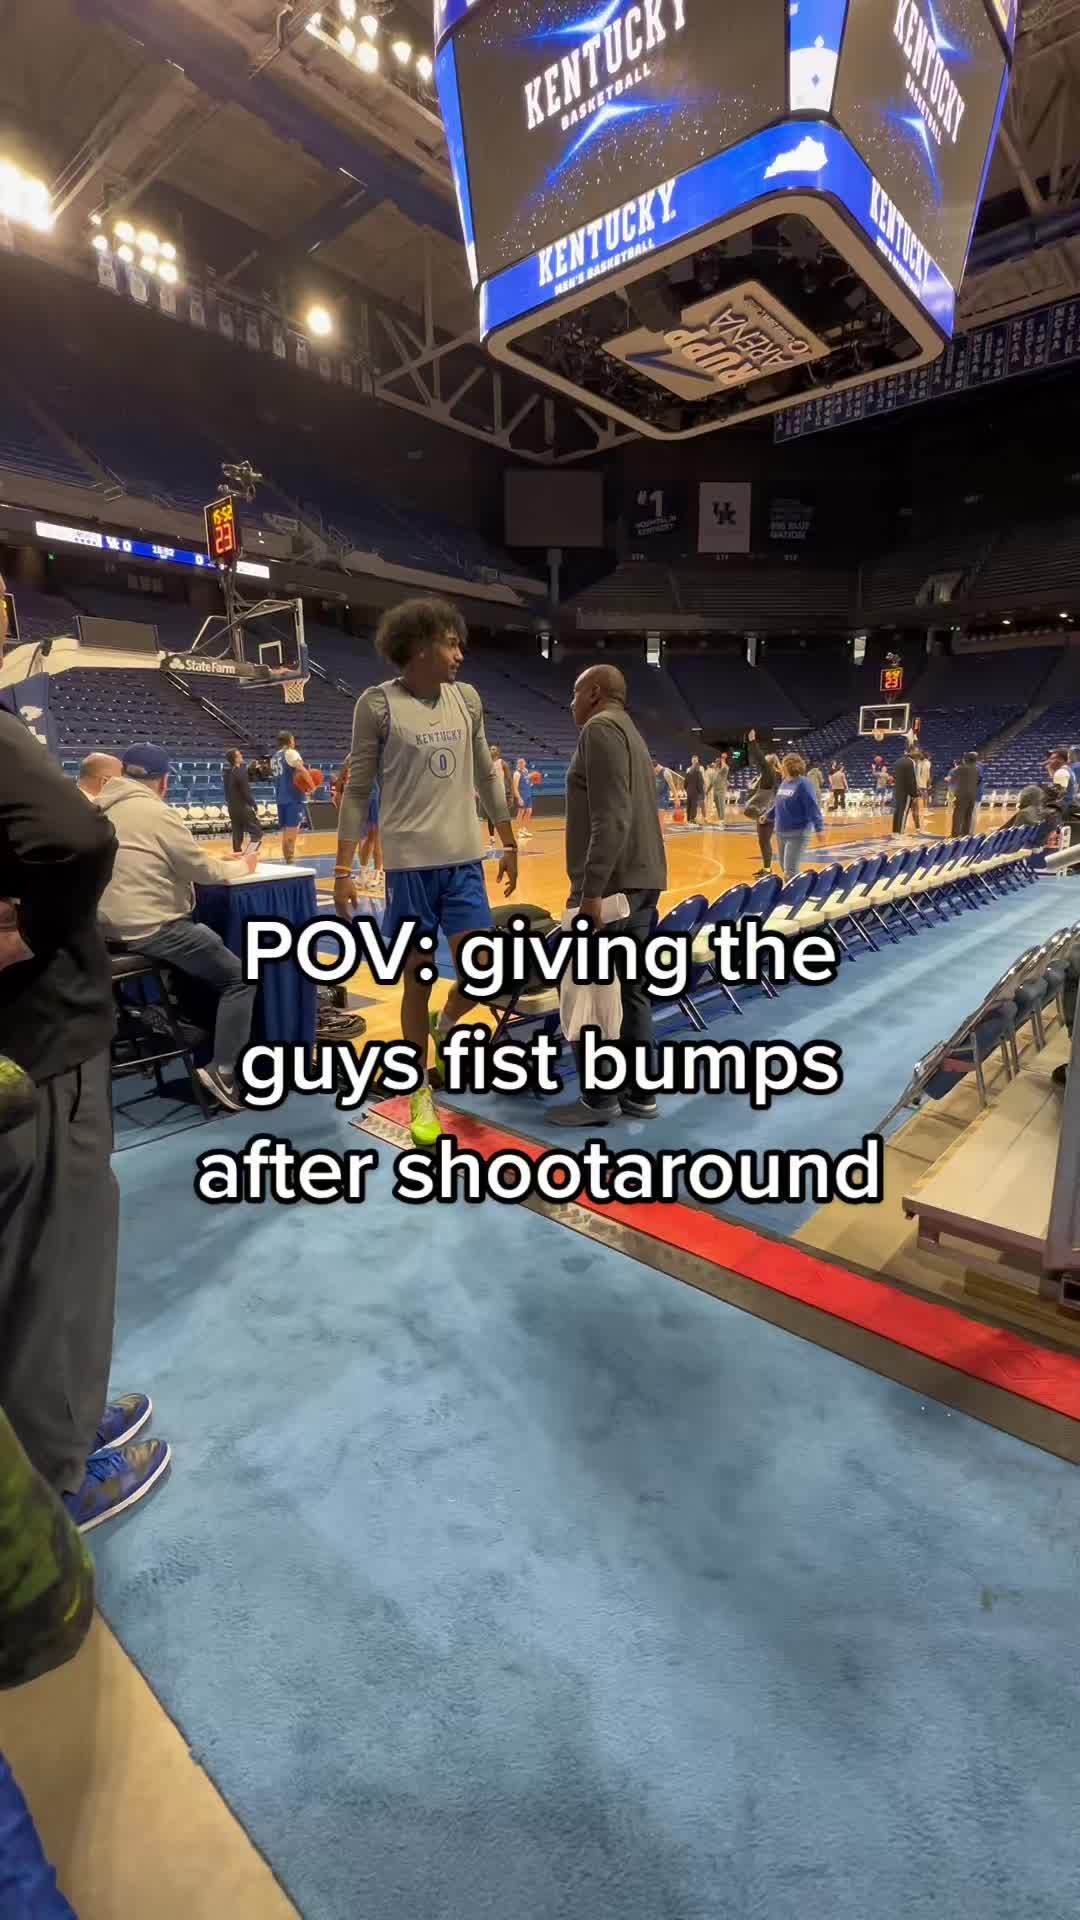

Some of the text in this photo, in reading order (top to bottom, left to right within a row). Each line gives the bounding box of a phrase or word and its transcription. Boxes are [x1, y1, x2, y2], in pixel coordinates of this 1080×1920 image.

[524, 0, 685, 130] KENTUCKY
[893, 0, 965, 143] KENTUCKY
[561, 62, 652, 131] BASKETBALL
[663, 328, 761, 385] RUPP
[709, 308, 796, 367] ARENA
[215, 523, 233, 553] 23
[416, 729, 463, 745] KENTUCKY
[440, 754, 448, 771] 0
